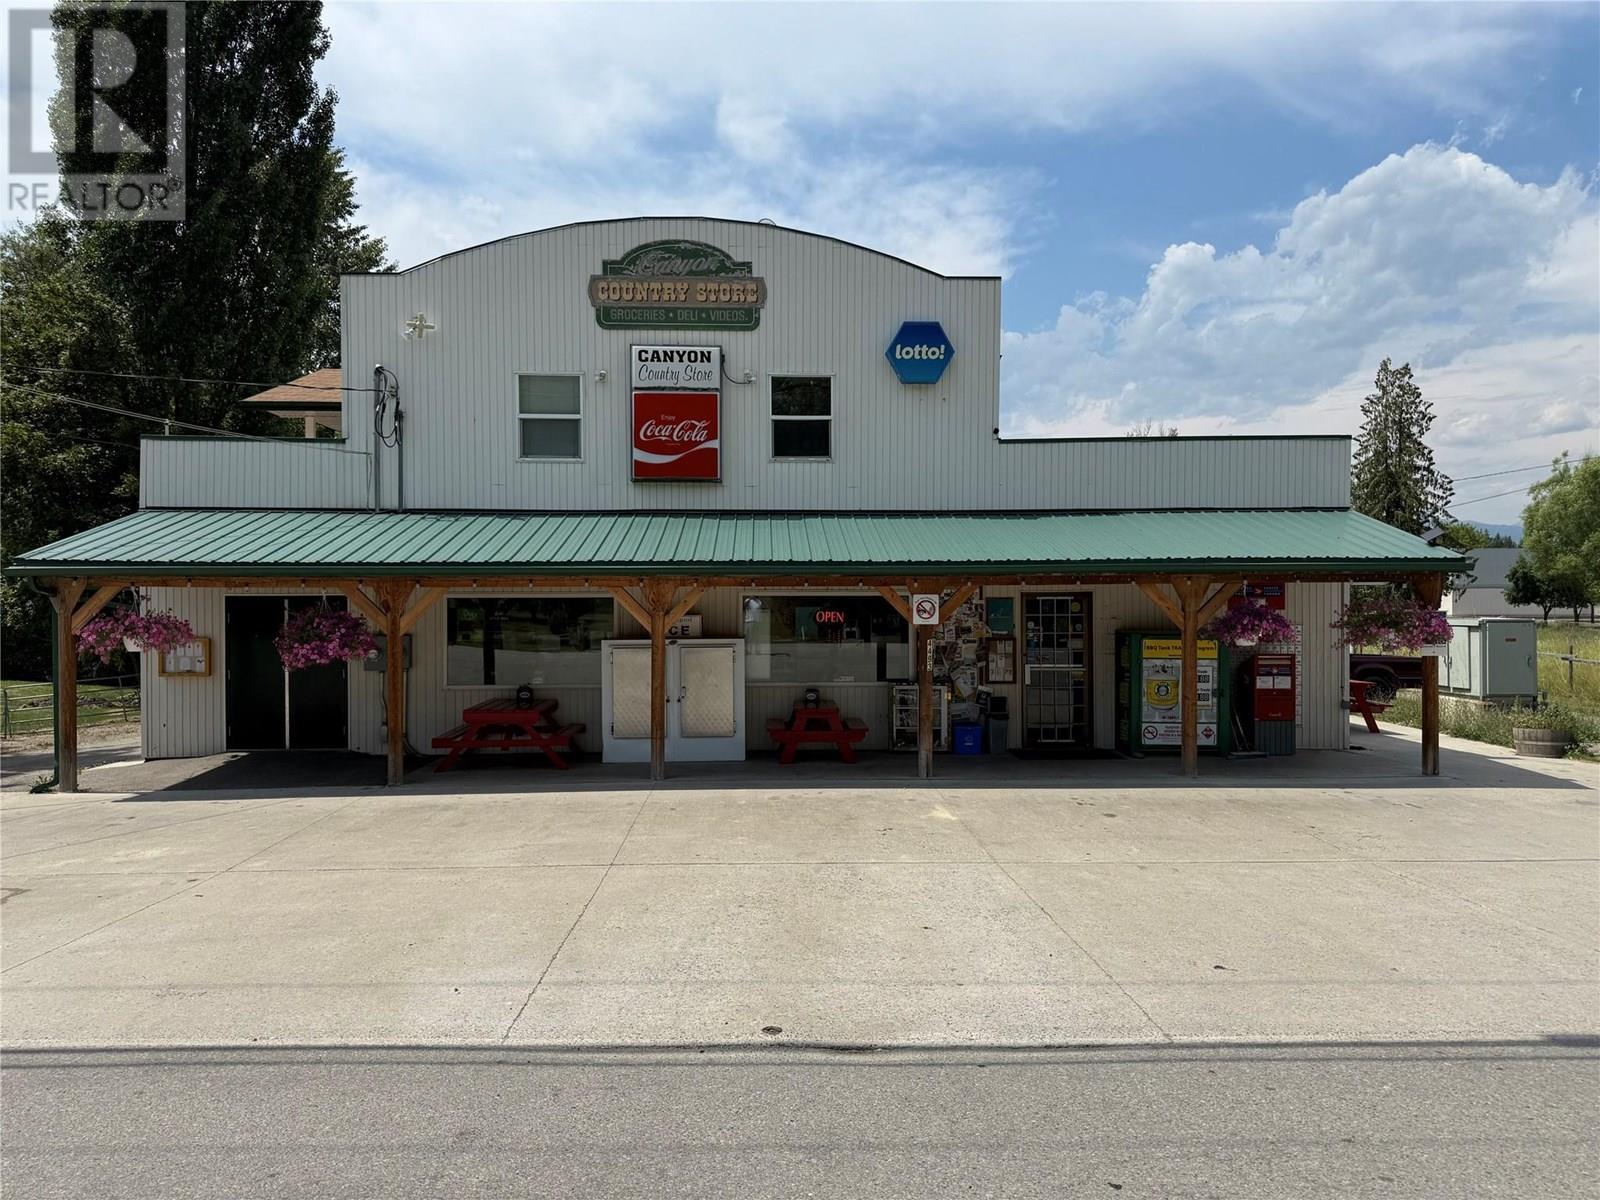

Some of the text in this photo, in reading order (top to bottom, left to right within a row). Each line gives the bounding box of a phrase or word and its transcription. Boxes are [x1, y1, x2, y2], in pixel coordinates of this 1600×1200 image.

[597, 282, 759, 303] COUNTRY STORE
[609, 310, 665, 321] GROCERIES
[677, 311, 699, 321] DELI
[638, 350, 712, 363] CANYON
[895, 344, 946, 360] lotto!
[638, 364, 713, 385] Country Store
[640, 419, 711, 441] Coca-Cola
[816, 611, 845, 623] OPEN
